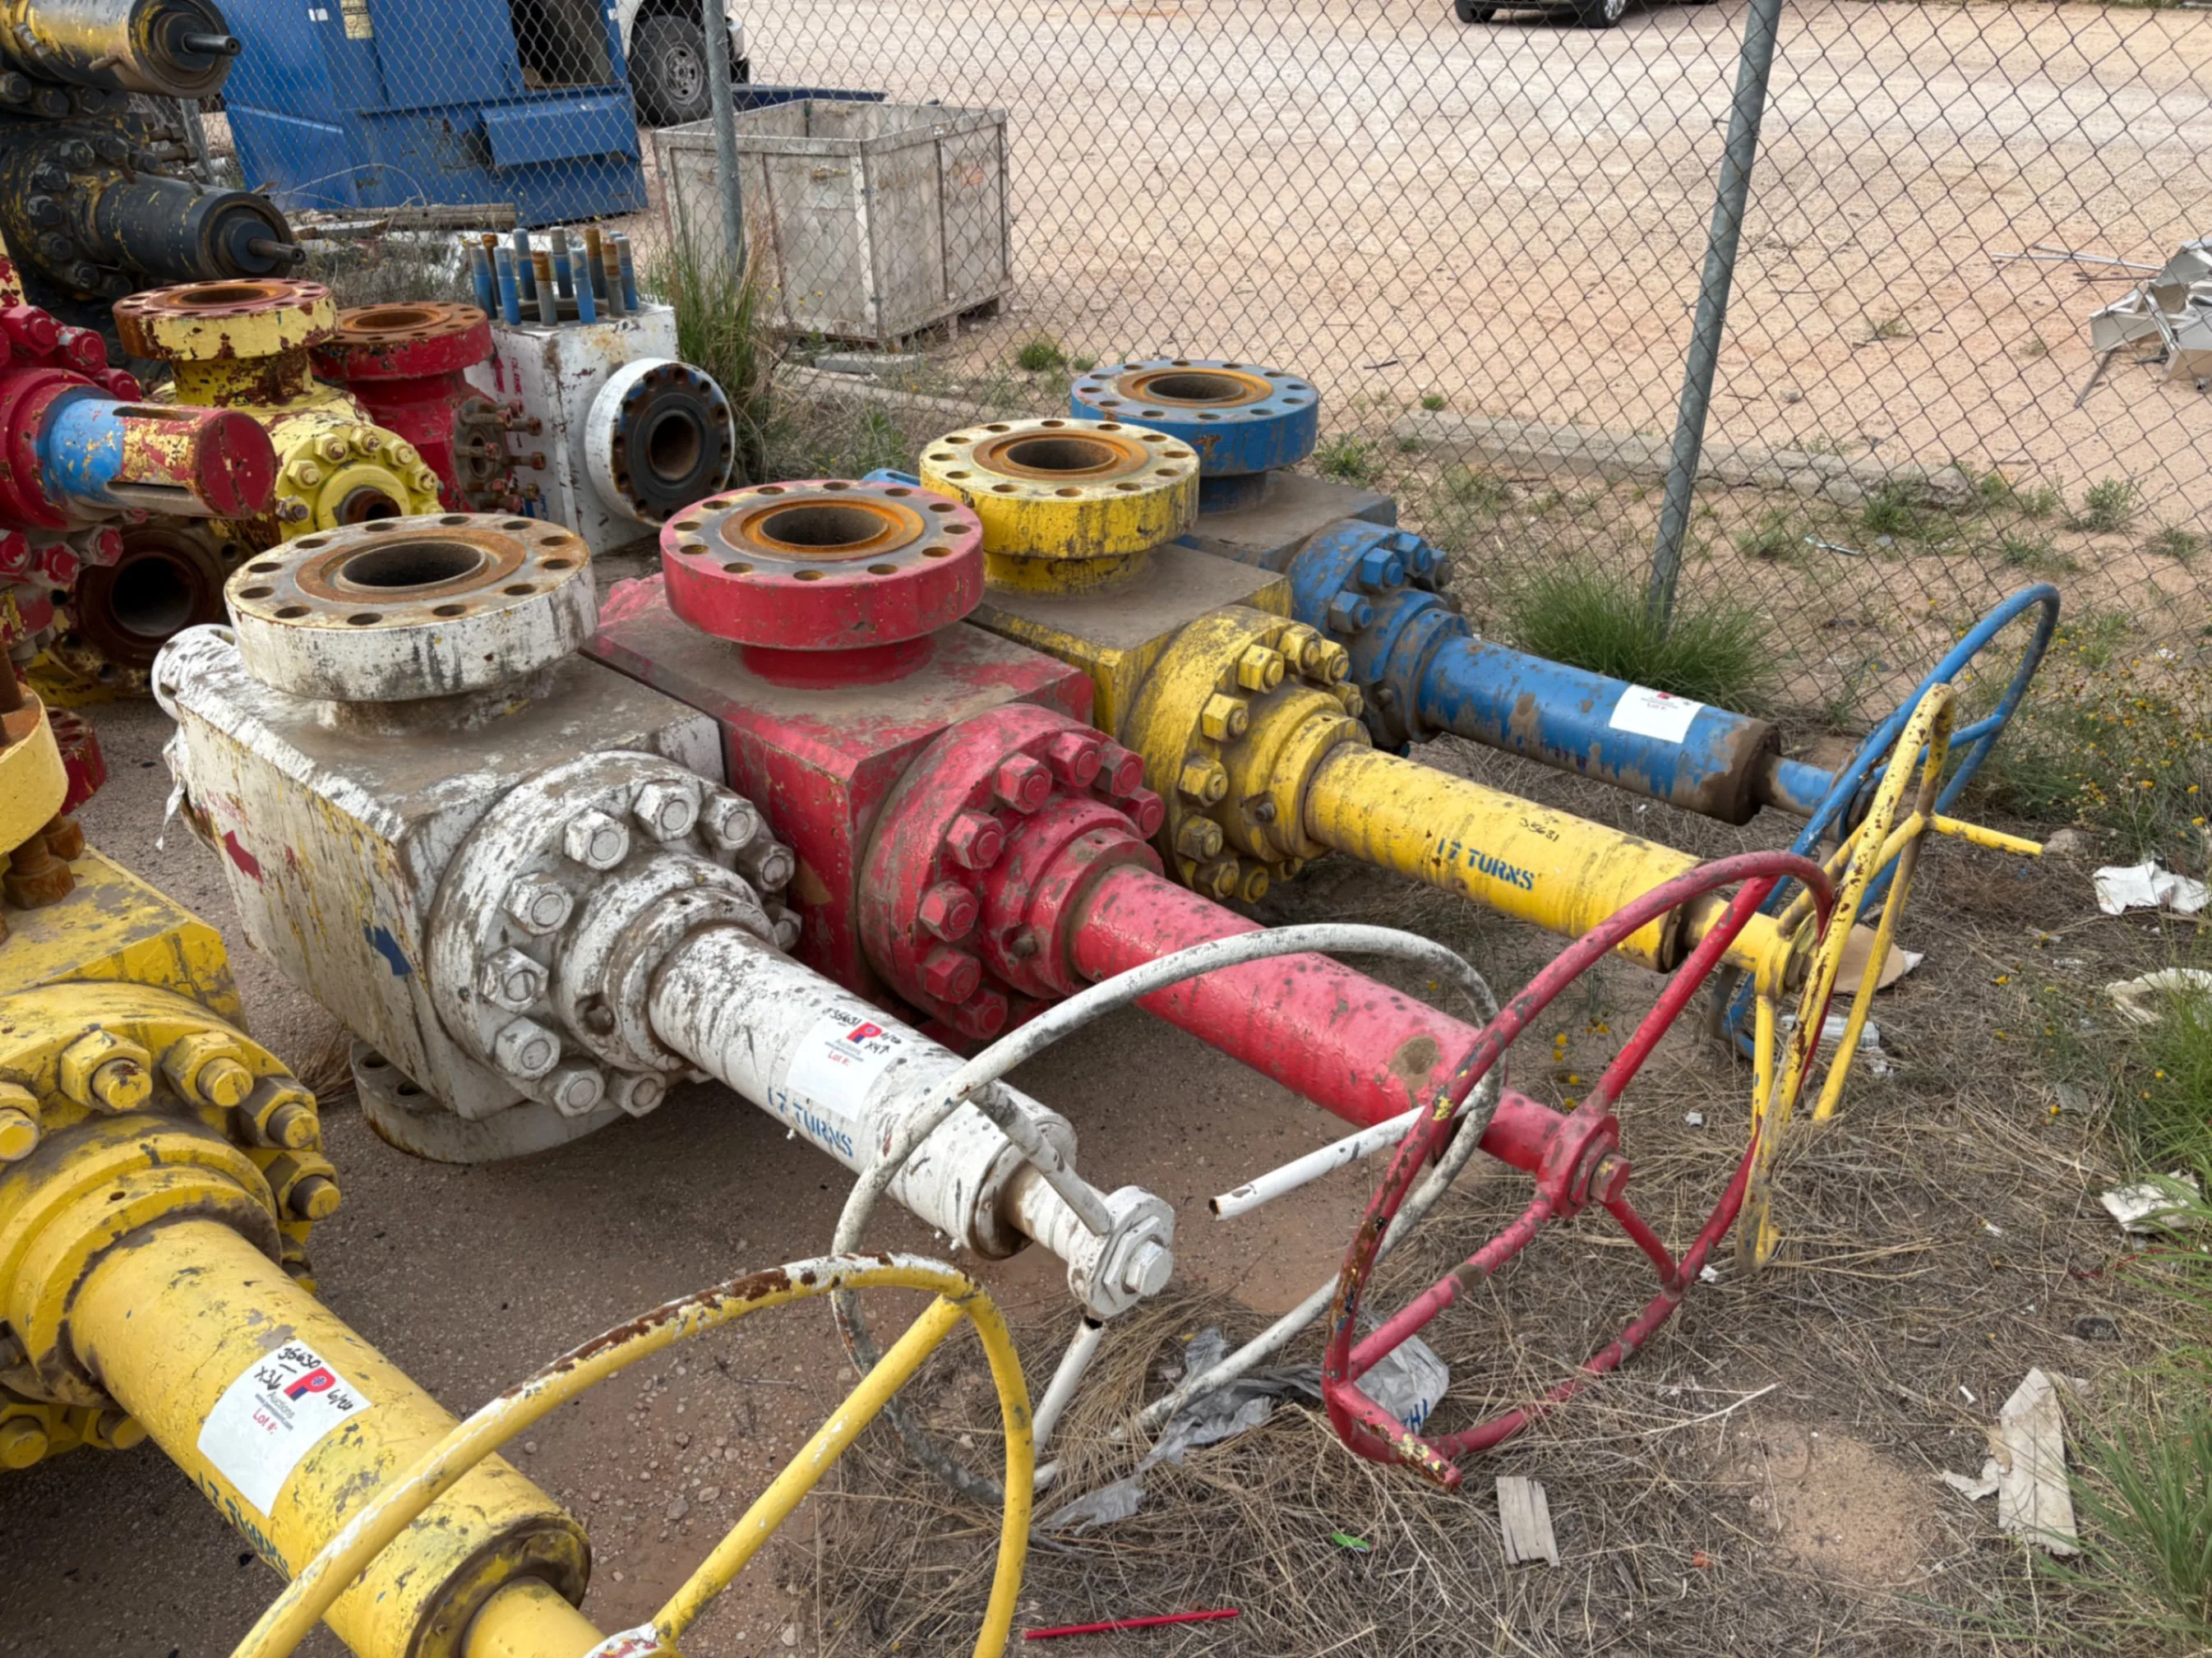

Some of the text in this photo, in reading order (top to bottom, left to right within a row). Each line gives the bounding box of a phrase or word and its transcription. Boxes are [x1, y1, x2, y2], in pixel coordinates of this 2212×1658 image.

[1518, 817, 1560, 843] 35631
[1437, 838, 1535, 891] 17 TURNS
[768, 1086, 853, 1158] 17 TURNS
[252, 1407, 270, 1427] Lot
